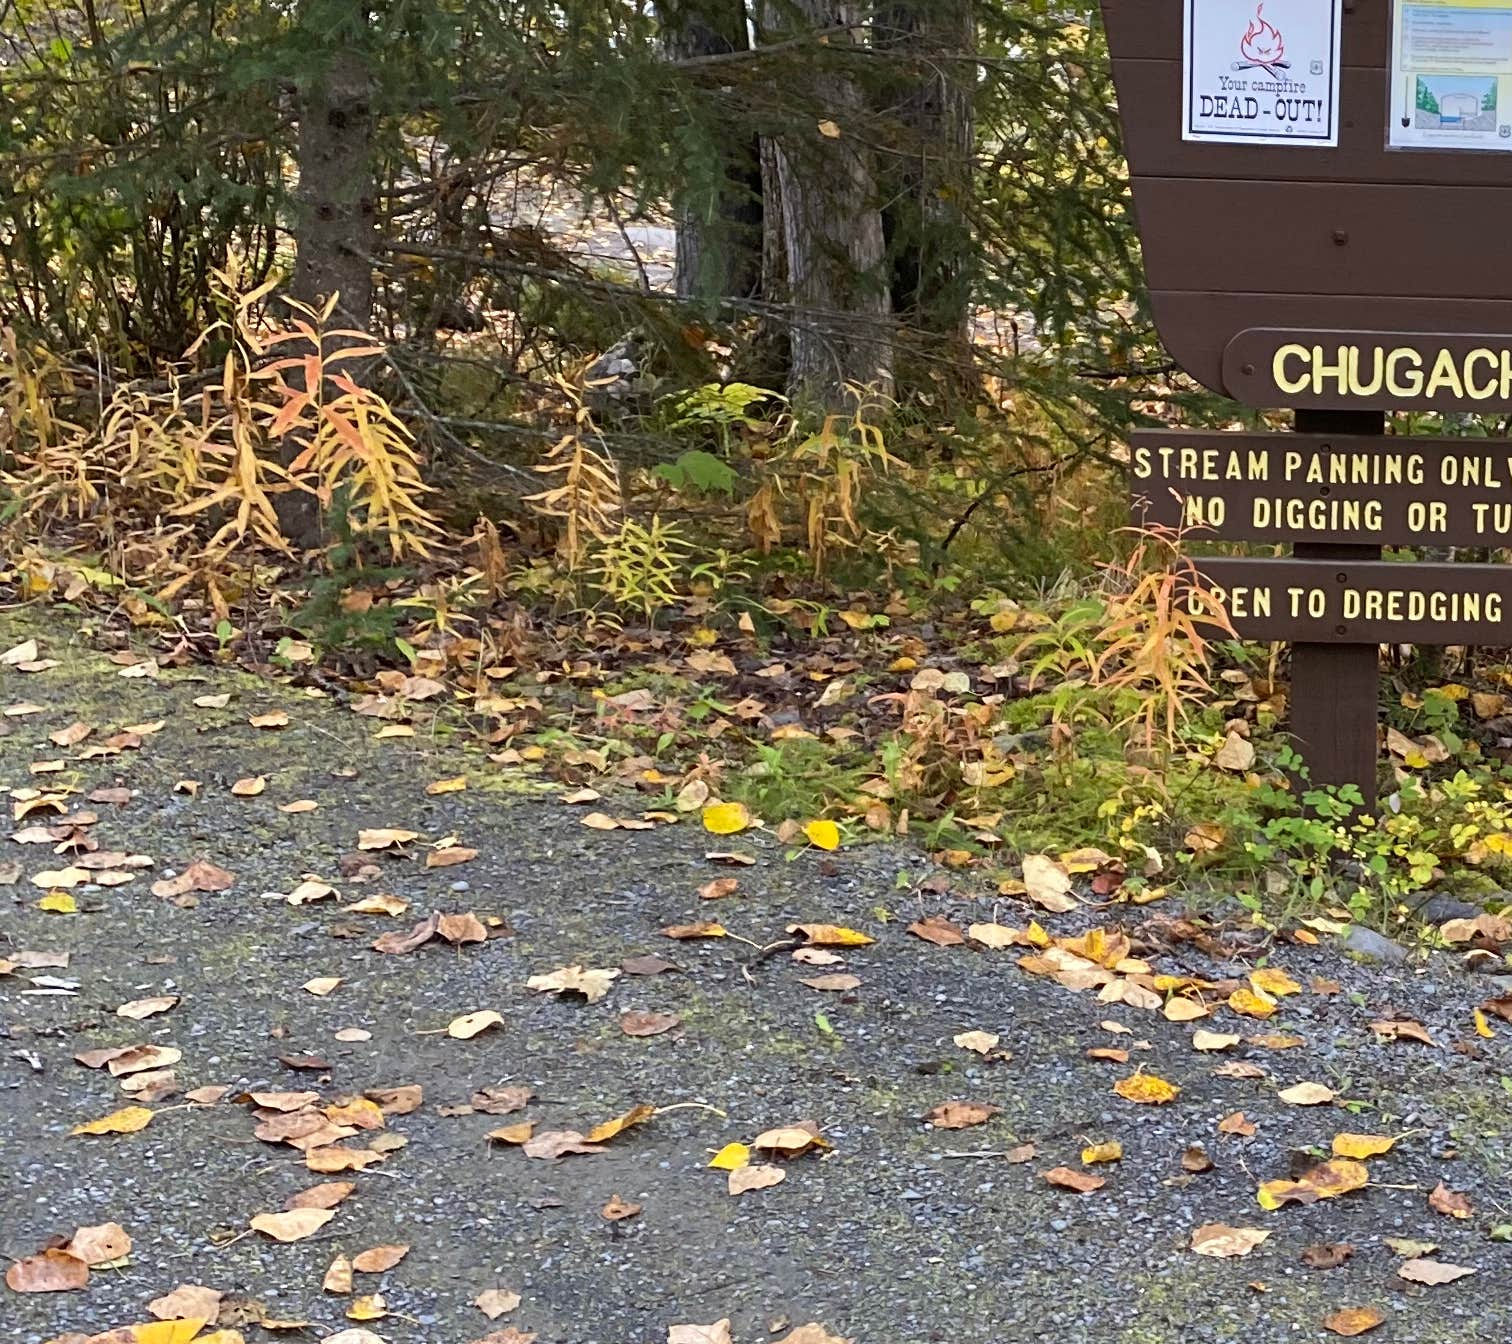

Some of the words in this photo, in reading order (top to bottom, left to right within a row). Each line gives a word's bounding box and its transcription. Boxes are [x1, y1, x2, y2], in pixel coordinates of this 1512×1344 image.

[1219, 76, 1248, 91] Your
[1251, 77, 1306, 97] campfire
[1134, 447, 1268, 481] STREAM
[1285, 453, 1424, 484] PANNING
[1186, 495, 1225, 526] NO
[1253, 497, 1382, 531] DIGGING
[1408, 502, 1447, 532] OR
[1288, 588, 1325, 618] TO
[1343, 589, 1502, 623] DREDGING
